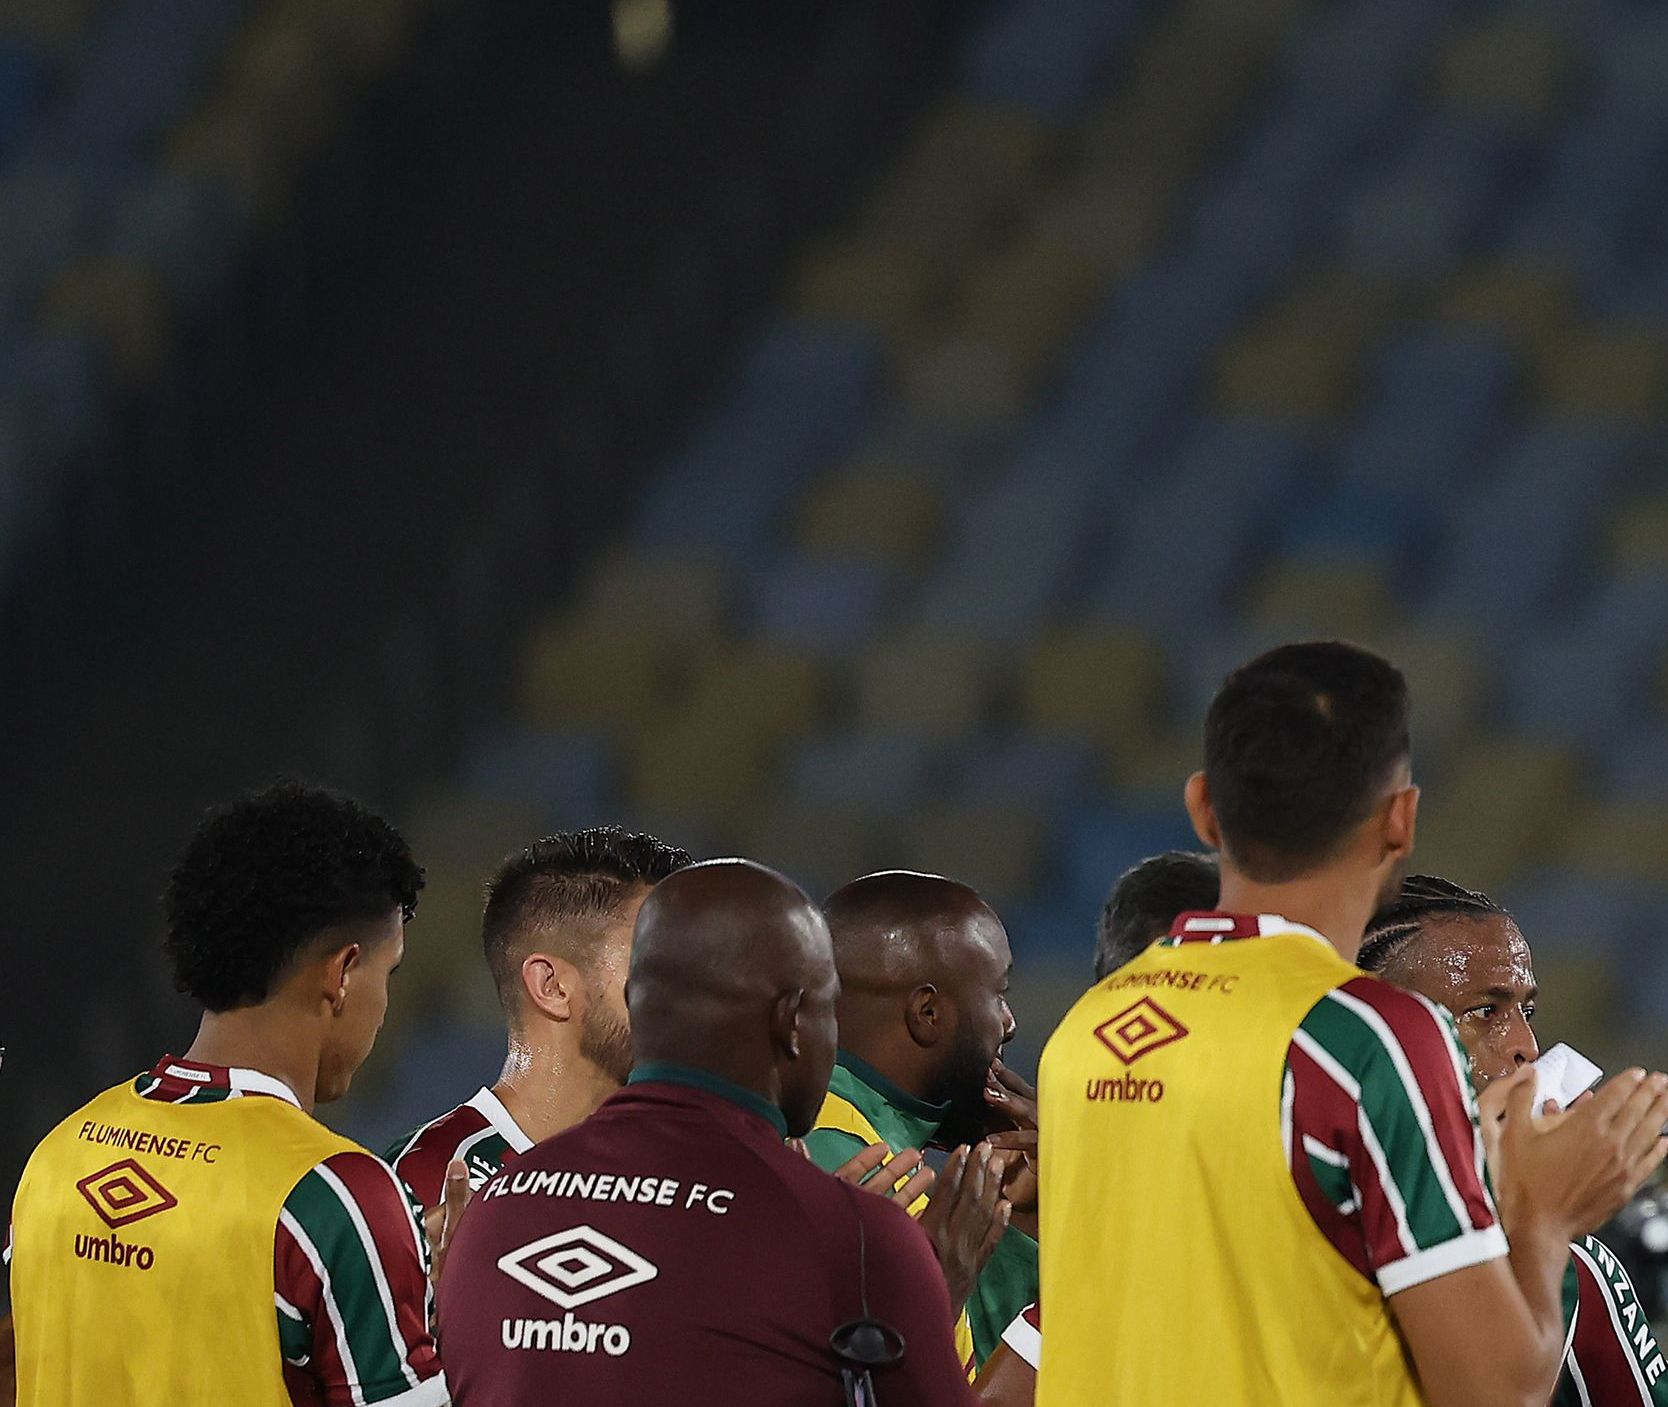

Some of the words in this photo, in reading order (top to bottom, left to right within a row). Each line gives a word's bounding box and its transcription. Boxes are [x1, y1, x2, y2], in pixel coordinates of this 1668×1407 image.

[1087, 1070, 1164, 1103] umbro
[78, 1121, 191, 1159] FLUMINENSE
[192, 1142, 221, 1163] FC
[483, 1170, 680, 1206] FLUMINENSE
[685, 1184, 735, 1214] FC
[75, 1234, 153, 1270] umbro
[502, 1312, 631, 1357] umbro
